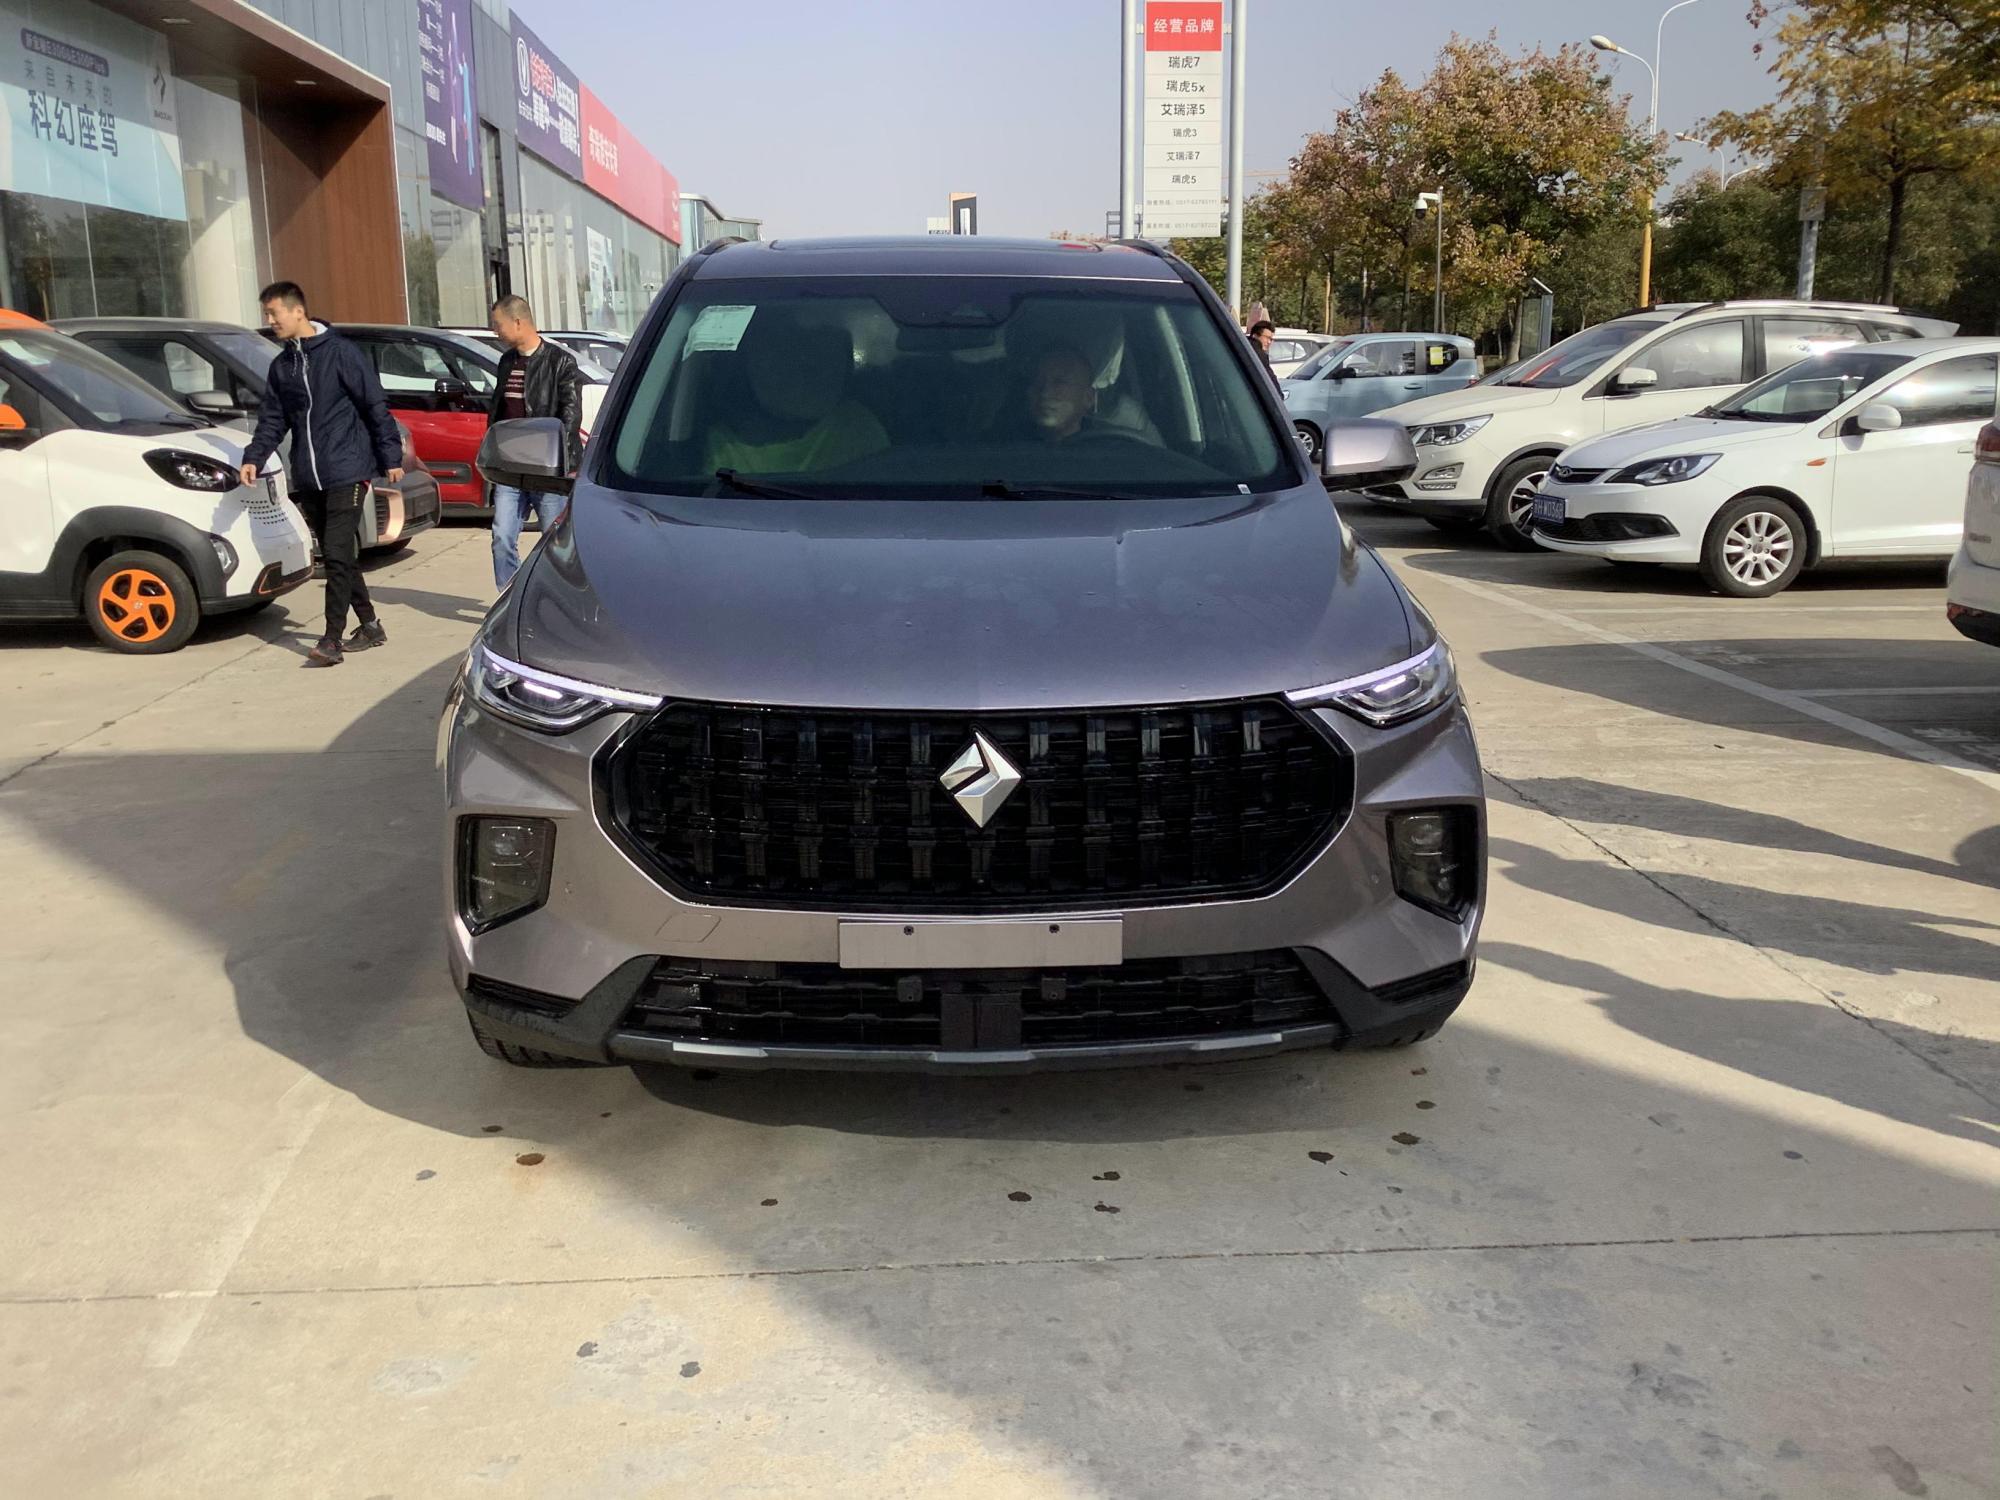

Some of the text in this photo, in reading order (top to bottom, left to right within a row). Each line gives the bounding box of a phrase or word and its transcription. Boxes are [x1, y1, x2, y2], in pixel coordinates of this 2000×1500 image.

[1153, 18, 1214, 33] 经营品牌
[1168, 56, 1200, 69] 瑞虎7
[1161, 103, 1205, 116] 艾瑞泽5
[28, 90, 118, 157] 科幻座驾
[1172, 128, 1198, 138] 瑞虎3
[1166, 151, 1200, 161] 艾瑞泽7
[1171, 175, 1197, 184] 瑞虎5
